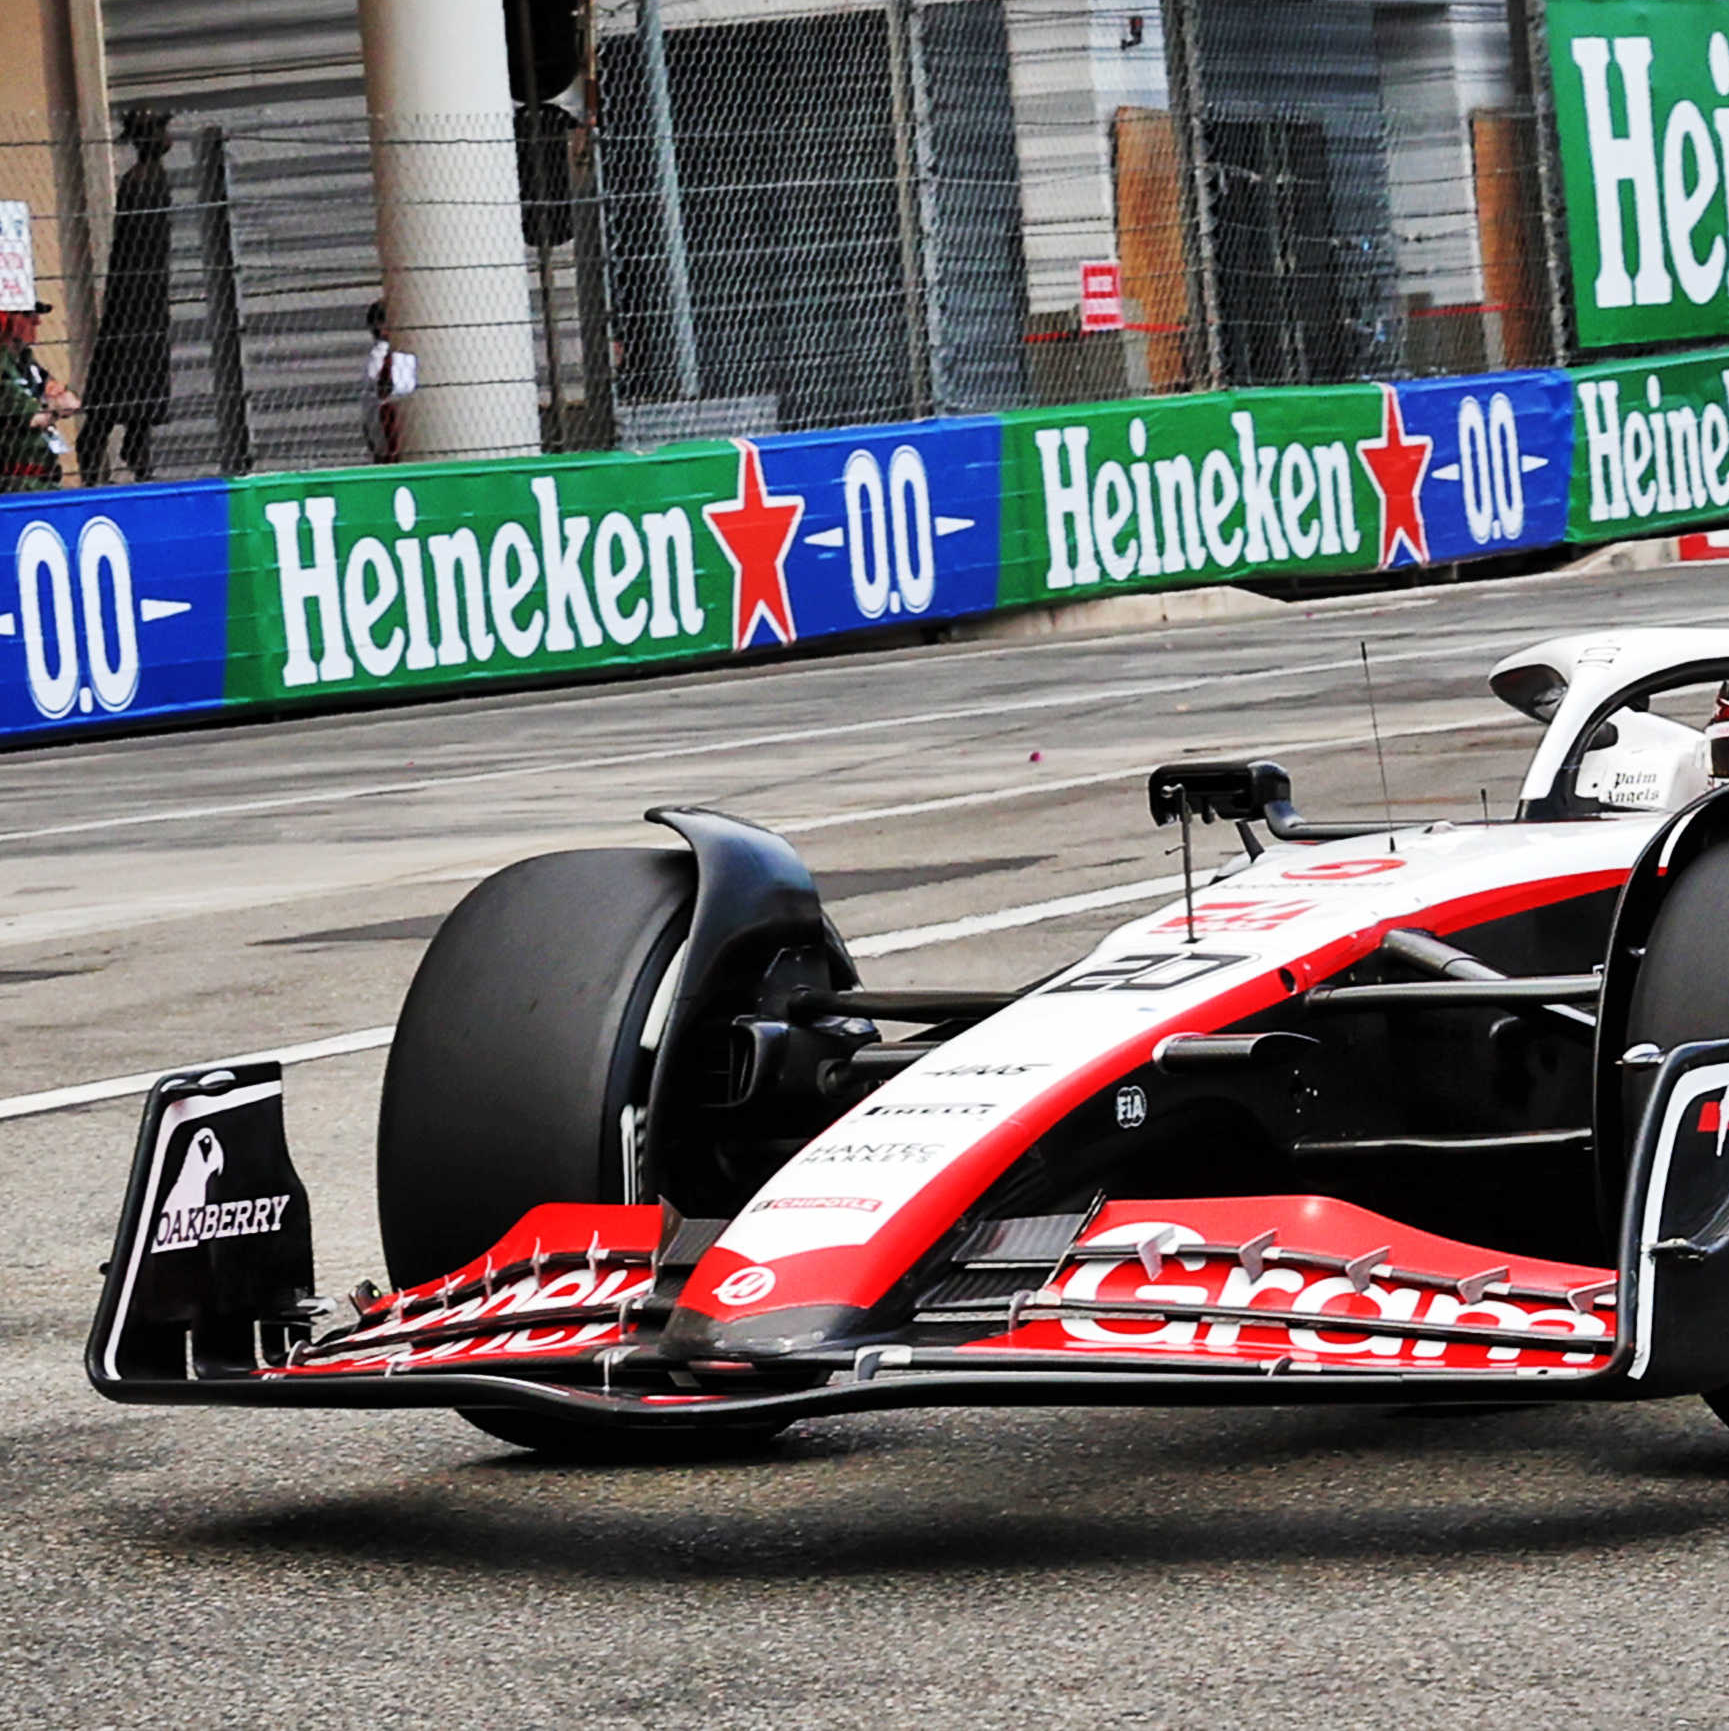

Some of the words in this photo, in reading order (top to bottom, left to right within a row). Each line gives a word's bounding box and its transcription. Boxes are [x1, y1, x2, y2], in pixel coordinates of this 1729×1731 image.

[1036, 412, 1361, 589] Heineken
[1457, 392, 1525, 544] 0.0
[265, 477, 705, 687] Heineken
[843, 444, 935, 620] 0.0
[16, 515, 142, 720] 0.0
[863, 1103, 999, 1118] PIRELLI
[798, 1154, 934, 1166] MARKETS
[811, 1143, 946, 1155] HANTEC
[154, 1195, 291, 1248] OAKBERRY
[774, 1198, 879, 1212] CHIPOTLE
[1059, 1221, 1608, 1363] Gram
